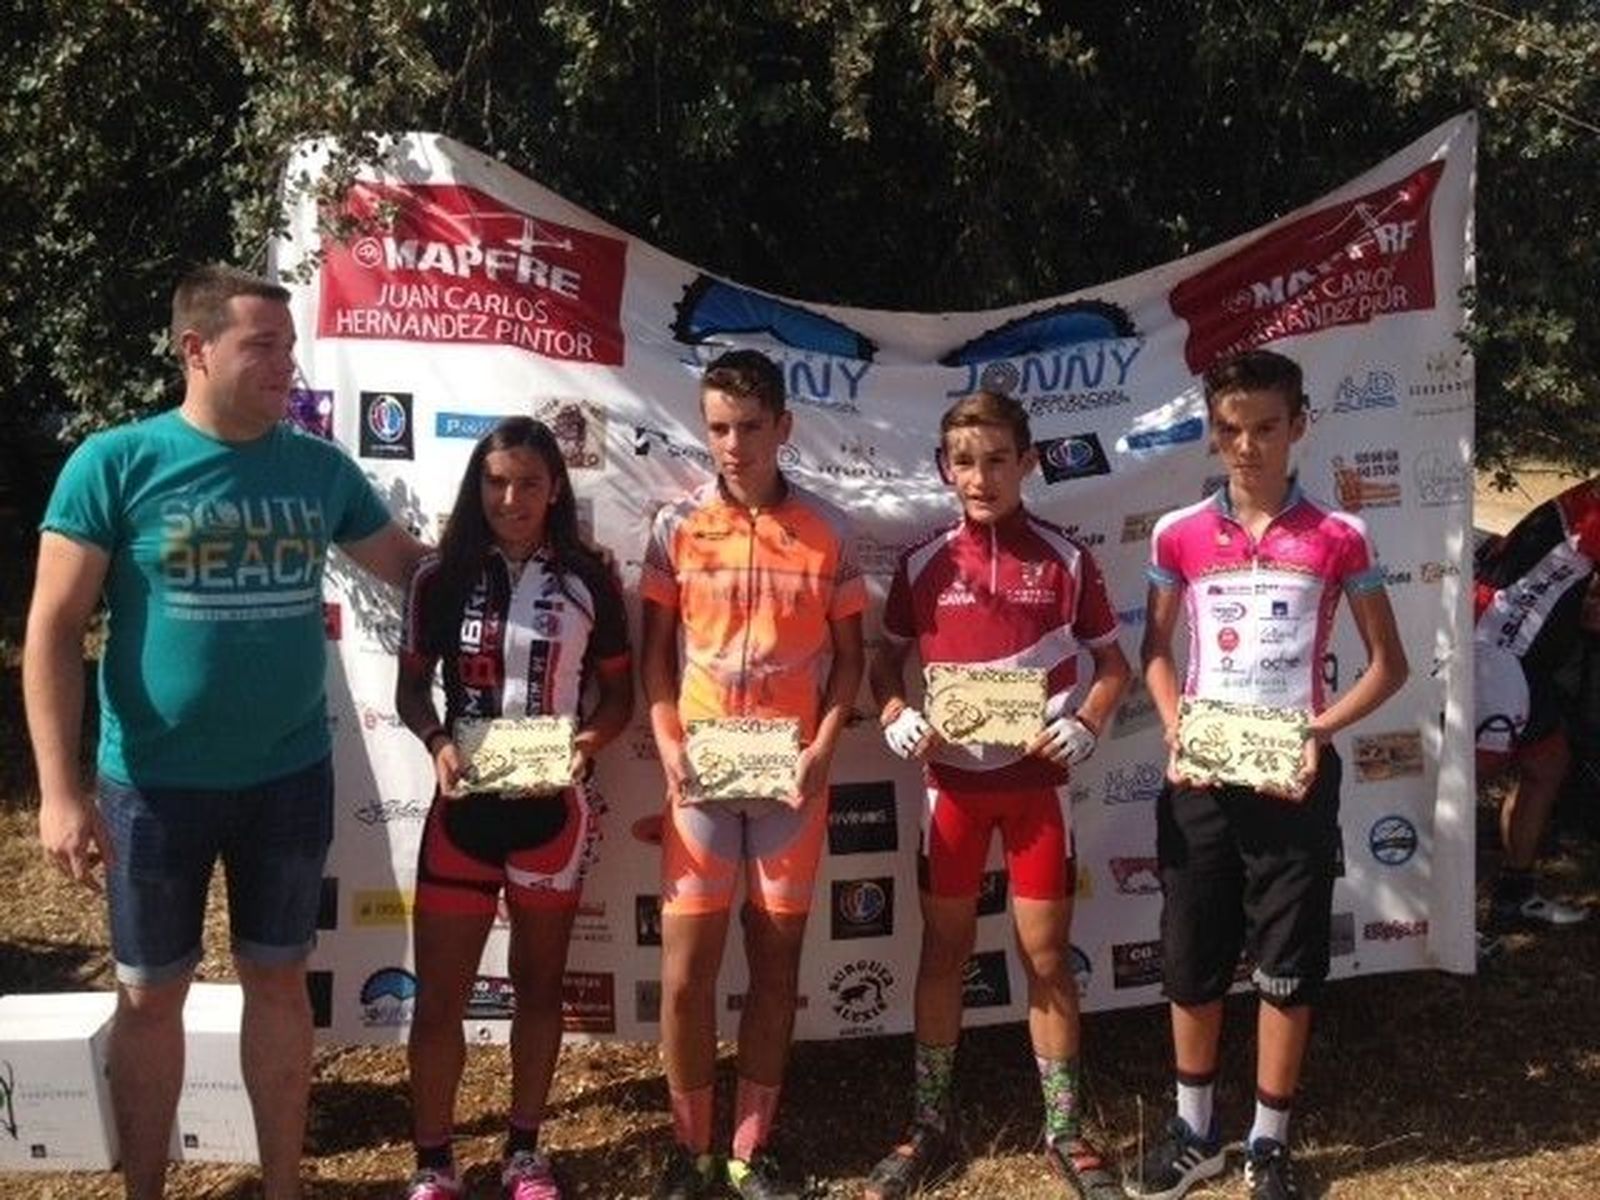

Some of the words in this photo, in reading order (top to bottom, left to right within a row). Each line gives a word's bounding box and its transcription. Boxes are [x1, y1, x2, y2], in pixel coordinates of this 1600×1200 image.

[383, 236, 582, 300] MAPFRE
[376, 284, 439, 309] JUAN
[444, 286, 549, 325] CARLOS
[336, 308, 488, 340] HERNANDEZ
[495, 319, 595, 359] PINTOR
[160, 497, 326, 539] SOUTH
